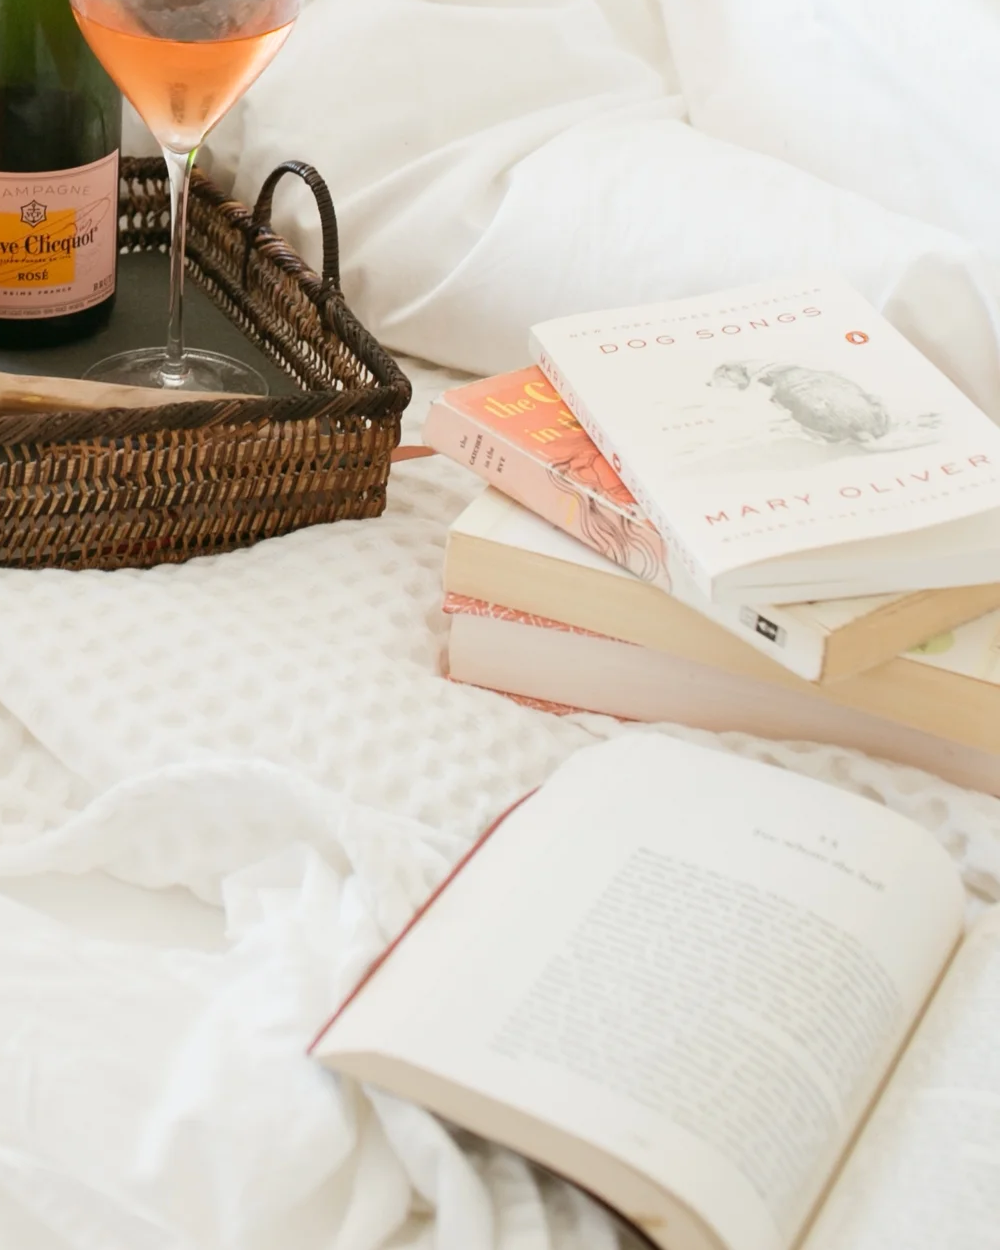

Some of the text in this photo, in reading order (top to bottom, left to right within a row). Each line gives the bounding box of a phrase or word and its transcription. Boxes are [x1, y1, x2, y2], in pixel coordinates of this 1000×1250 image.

[23, 227, 96, 255] Clicquot
[17, 268, 49, 281] ROSÉ
[93, 274, 113, 292] BRUT
[570, 288, 821, 338] NEW YORK TIMES BESTSELLER
[599, 306, 821, 354] DOG SONGS
[483, 396, 537, 419] the
[539, 353, 605, 445] MARY OLIVER
[459, 435, 468, 449] the
[524, 426, 563, 444] in
[469, 434, 483, 466] CATCHER
[496, 456, 506, 474] RYE
[704, 453, 992, 526] MARY OLIVER
